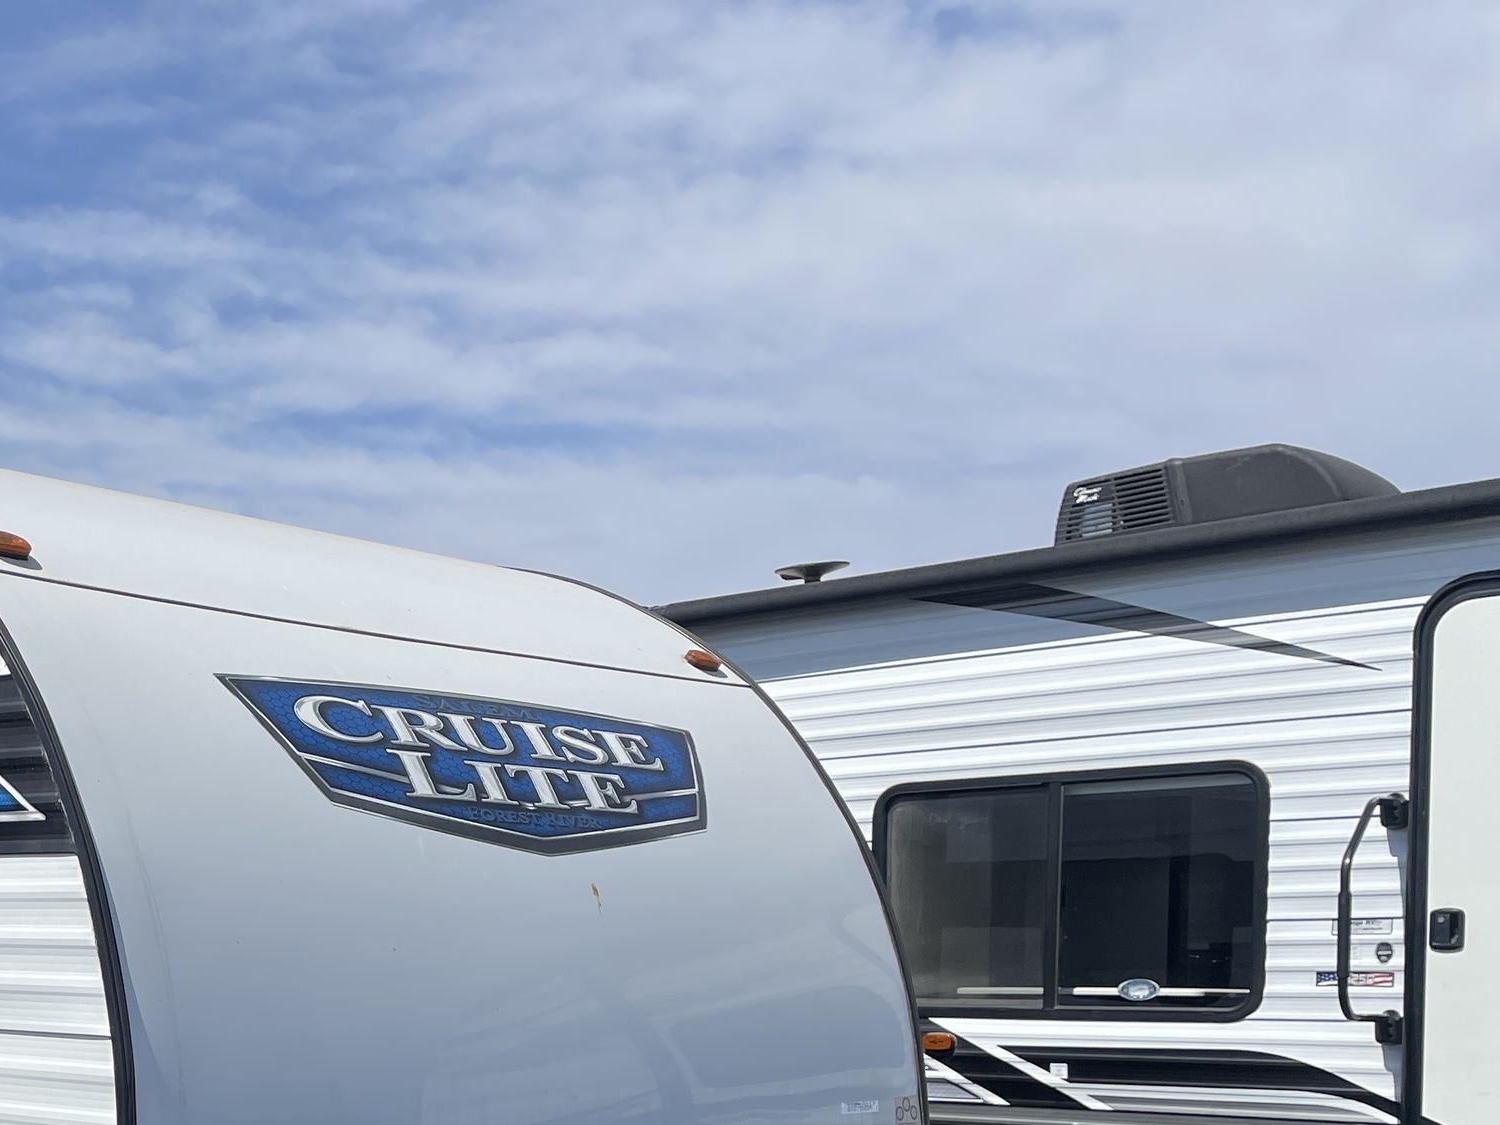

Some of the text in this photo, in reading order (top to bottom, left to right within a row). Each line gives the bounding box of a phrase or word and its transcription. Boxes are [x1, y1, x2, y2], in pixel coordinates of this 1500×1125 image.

[412, 694, 538, 721] SALEM
[292, 693, 668, 772] CRUISE
[385, 747, 640, 815] LITE
[467, 805, 603, 830] FOREST RIVER
